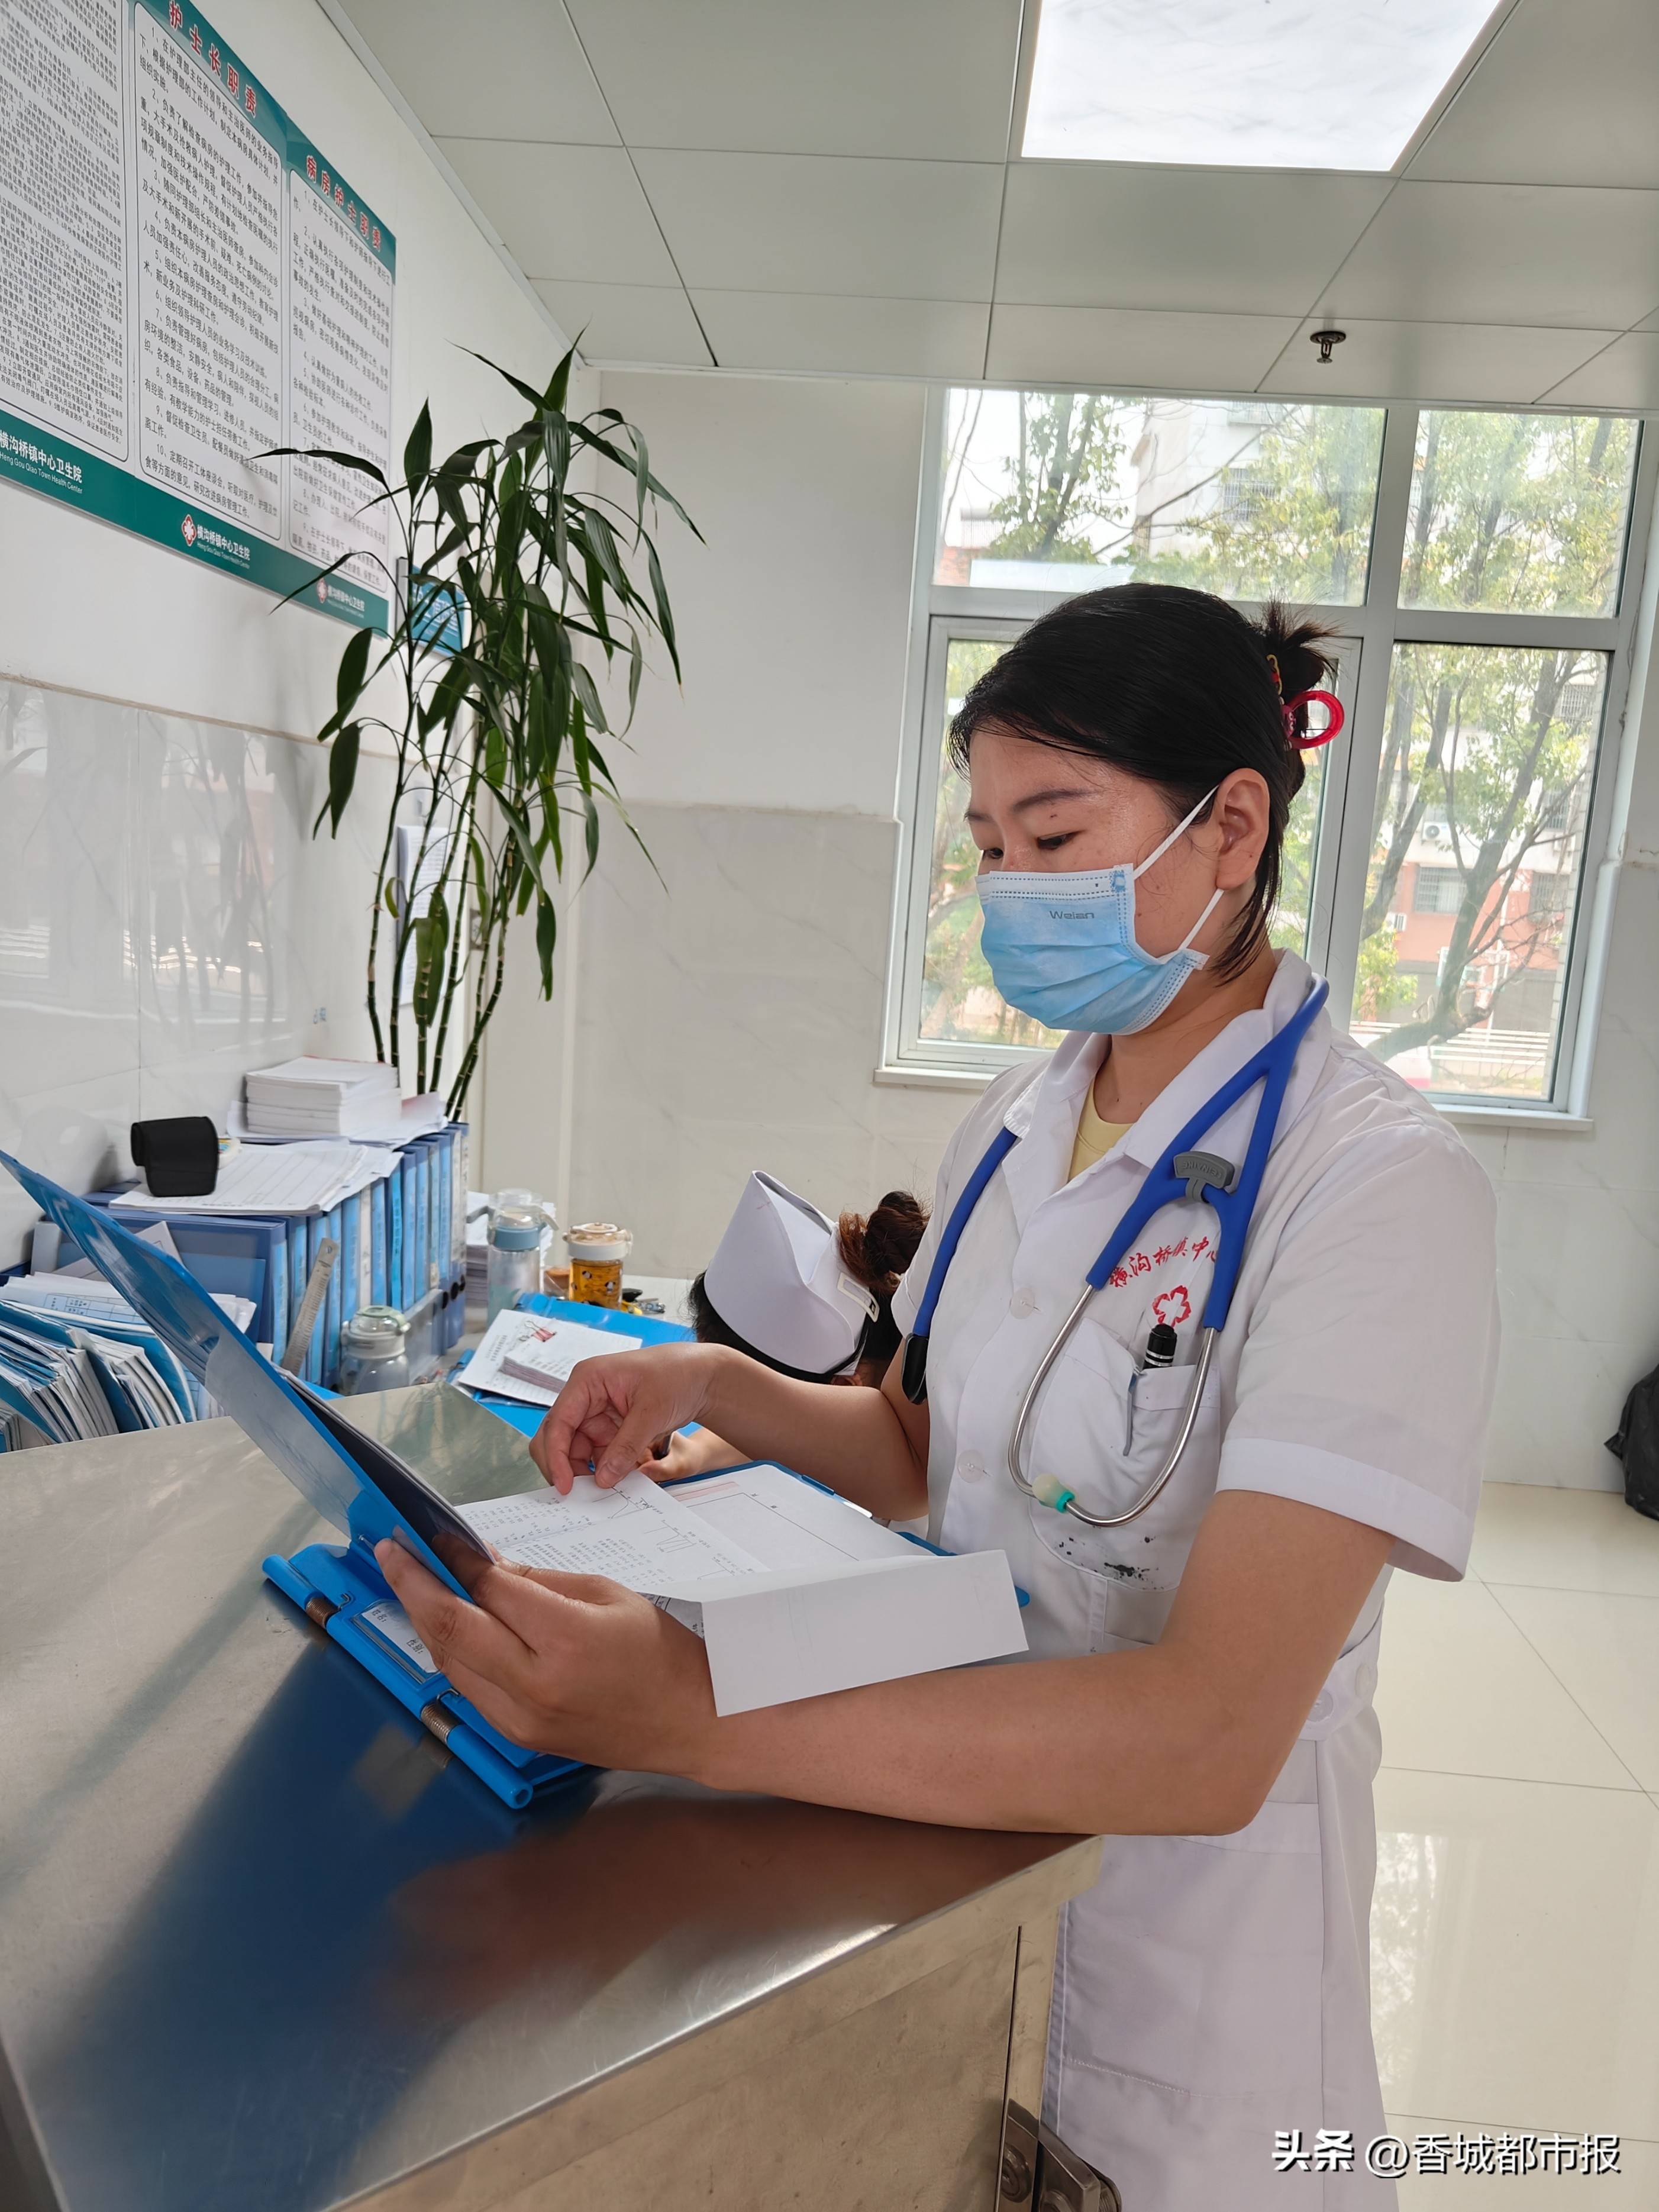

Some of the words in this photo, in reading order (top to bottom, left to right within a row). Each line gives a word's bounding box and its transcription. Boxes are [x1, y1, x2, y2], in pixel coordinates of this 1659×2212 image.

[169, 0, 256, 118] 护士长职责
